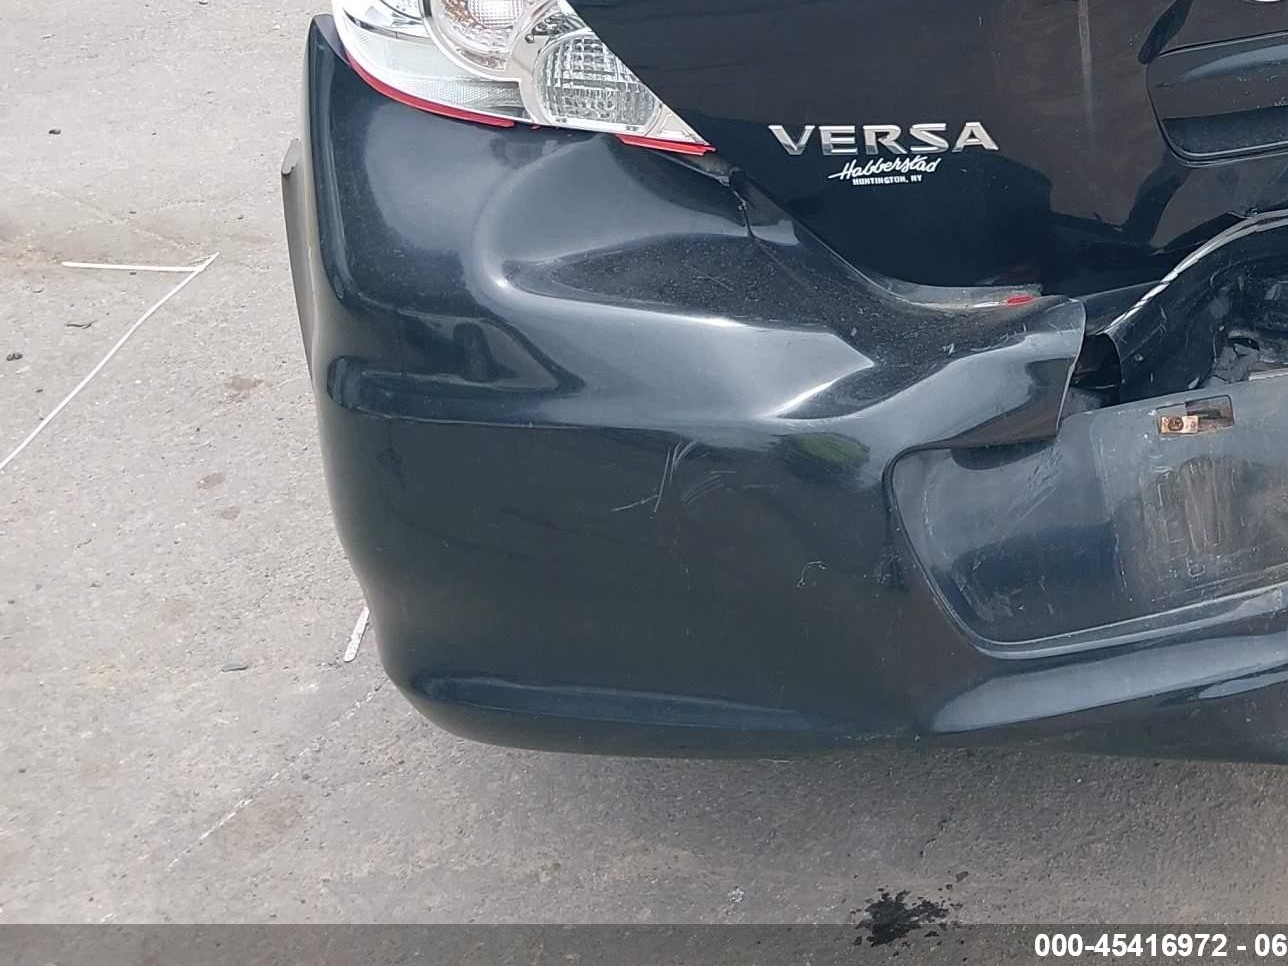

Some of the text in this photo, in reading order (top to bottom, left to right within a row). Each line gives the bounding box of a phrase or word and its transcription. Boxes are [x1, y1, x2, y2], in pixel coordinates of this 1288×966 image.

[768, 121, 999, 156] VERSA
[827, 154, 942, 180] Habberstad
[910, 174, 922, 182] NY
